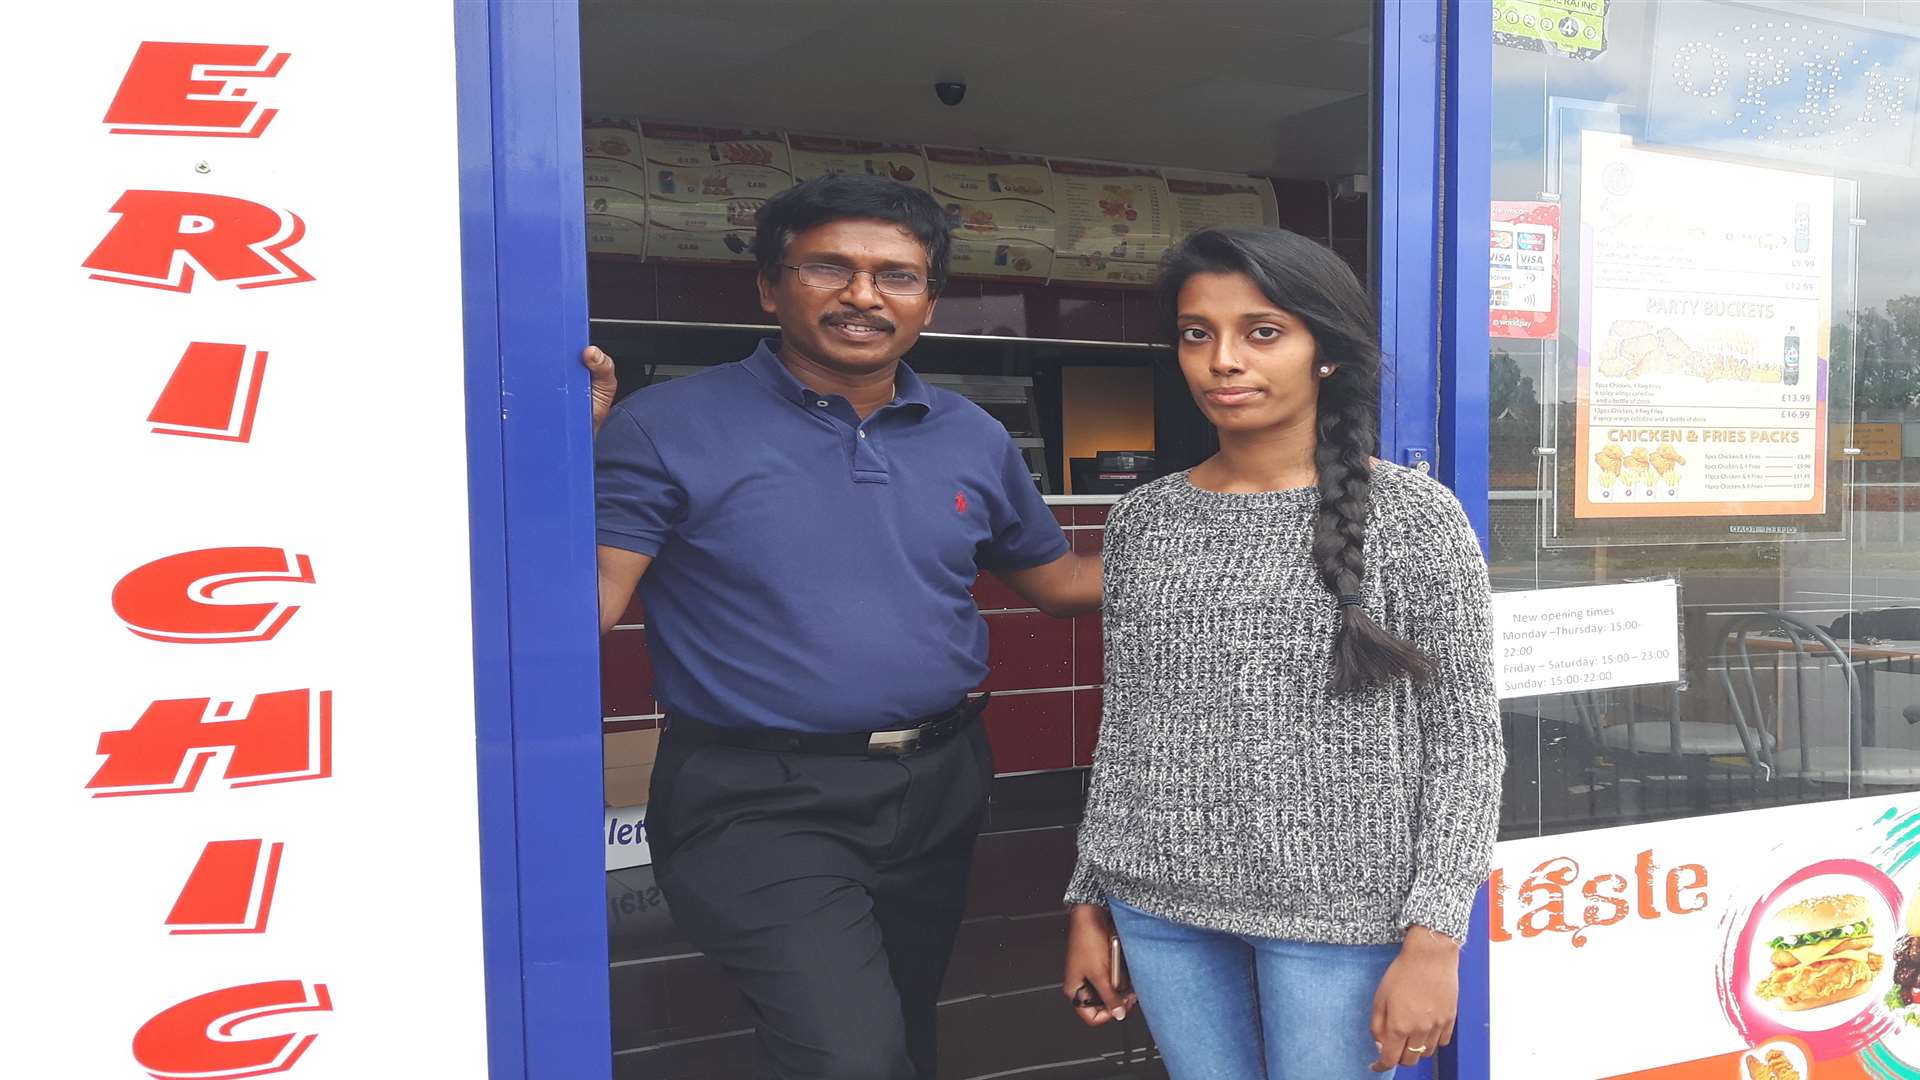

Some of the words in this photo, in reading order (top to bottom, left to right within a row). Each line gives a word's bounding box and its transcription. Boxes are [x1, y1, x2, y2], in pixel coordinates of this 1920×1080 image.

[1673, 40, 1911, 126] OPEN
[1520, 255, 1544, 264] VISA
[1646, 297, 1700, 316] PARTY
[1703, 299, 1776, 319] BUCKETS
[1781, 394, 1811, 403] £13.99
[1781, 410, 1810, 419] £16.99
[1607, 429, 1682, 442] CHICKEN
[1686, 430, 1699, 442] &
[1703, 431, 1746, 443] FRIES
[1750, 431, 1800, 443] PACKS
[1513, 613, 1538, 623] New
[1541, 609, 1583, 622] opening
[1586, 607, 1615, 617] times
[1503, 629, 1546, 640] Monday
[1503, 646, 1533, 657] 22:00
[1503, 664, 1536, 674] Friday
[1549, 657, 1598, 670] Saturday:
[1602, 652, 1629, 665] 15:00
[1641, 649, 1670, 660] 23:00
[1505, 679, 1546, 691] Sunday:
[1551, 671, 1612, 686] 15:00-22:00
[1489, 848, 1708, 948] taste
